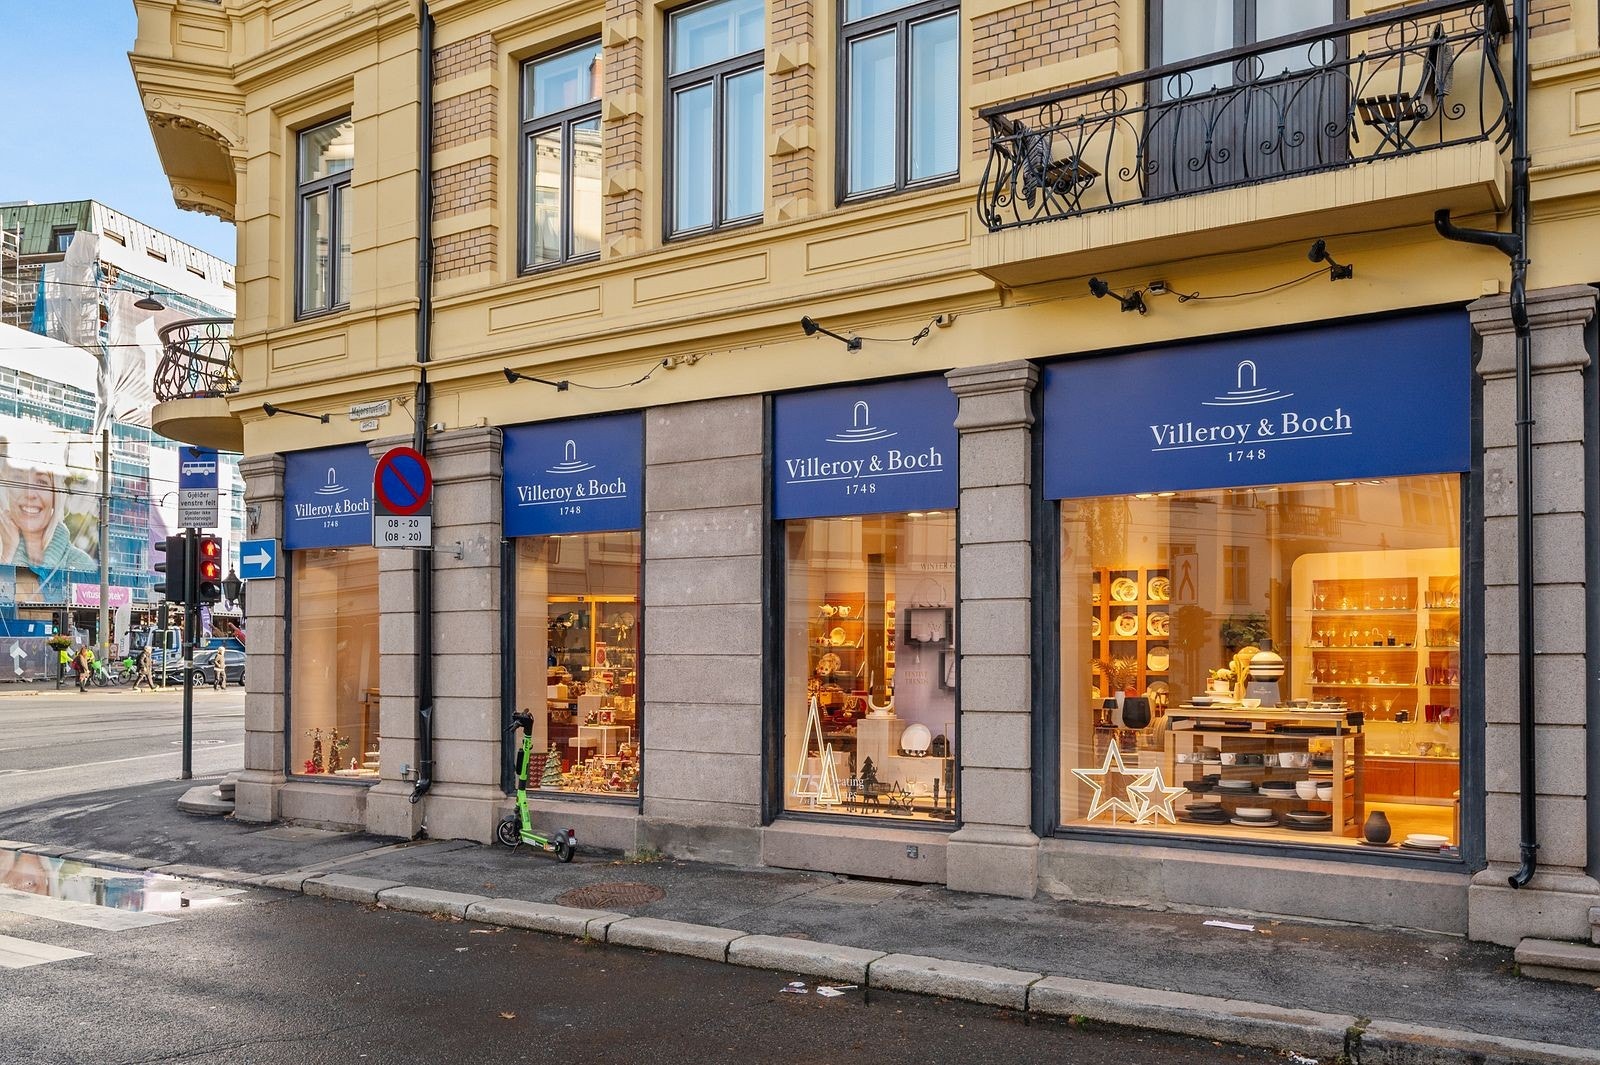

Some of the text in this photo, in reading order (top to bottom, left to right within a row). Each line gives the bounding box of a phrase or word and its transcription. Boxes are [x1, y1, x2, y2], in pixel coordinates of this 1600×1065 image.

[1150, 408, 1352, 445] Villeroy & Boch
[785, 447, 943, 478] Villeroy & Boch
[1228, 449, 1266, 462] 1748
[517, 477, 626, 502] Villeroy & Boch
[846, 483, 876, 495] 1748
[295, 498, 369, 518] Villeroy & Boch
[560, 506, 581, 515] 1748
[385, 531, 399, 541] (08
[408, 531, 422, 541] 20)
